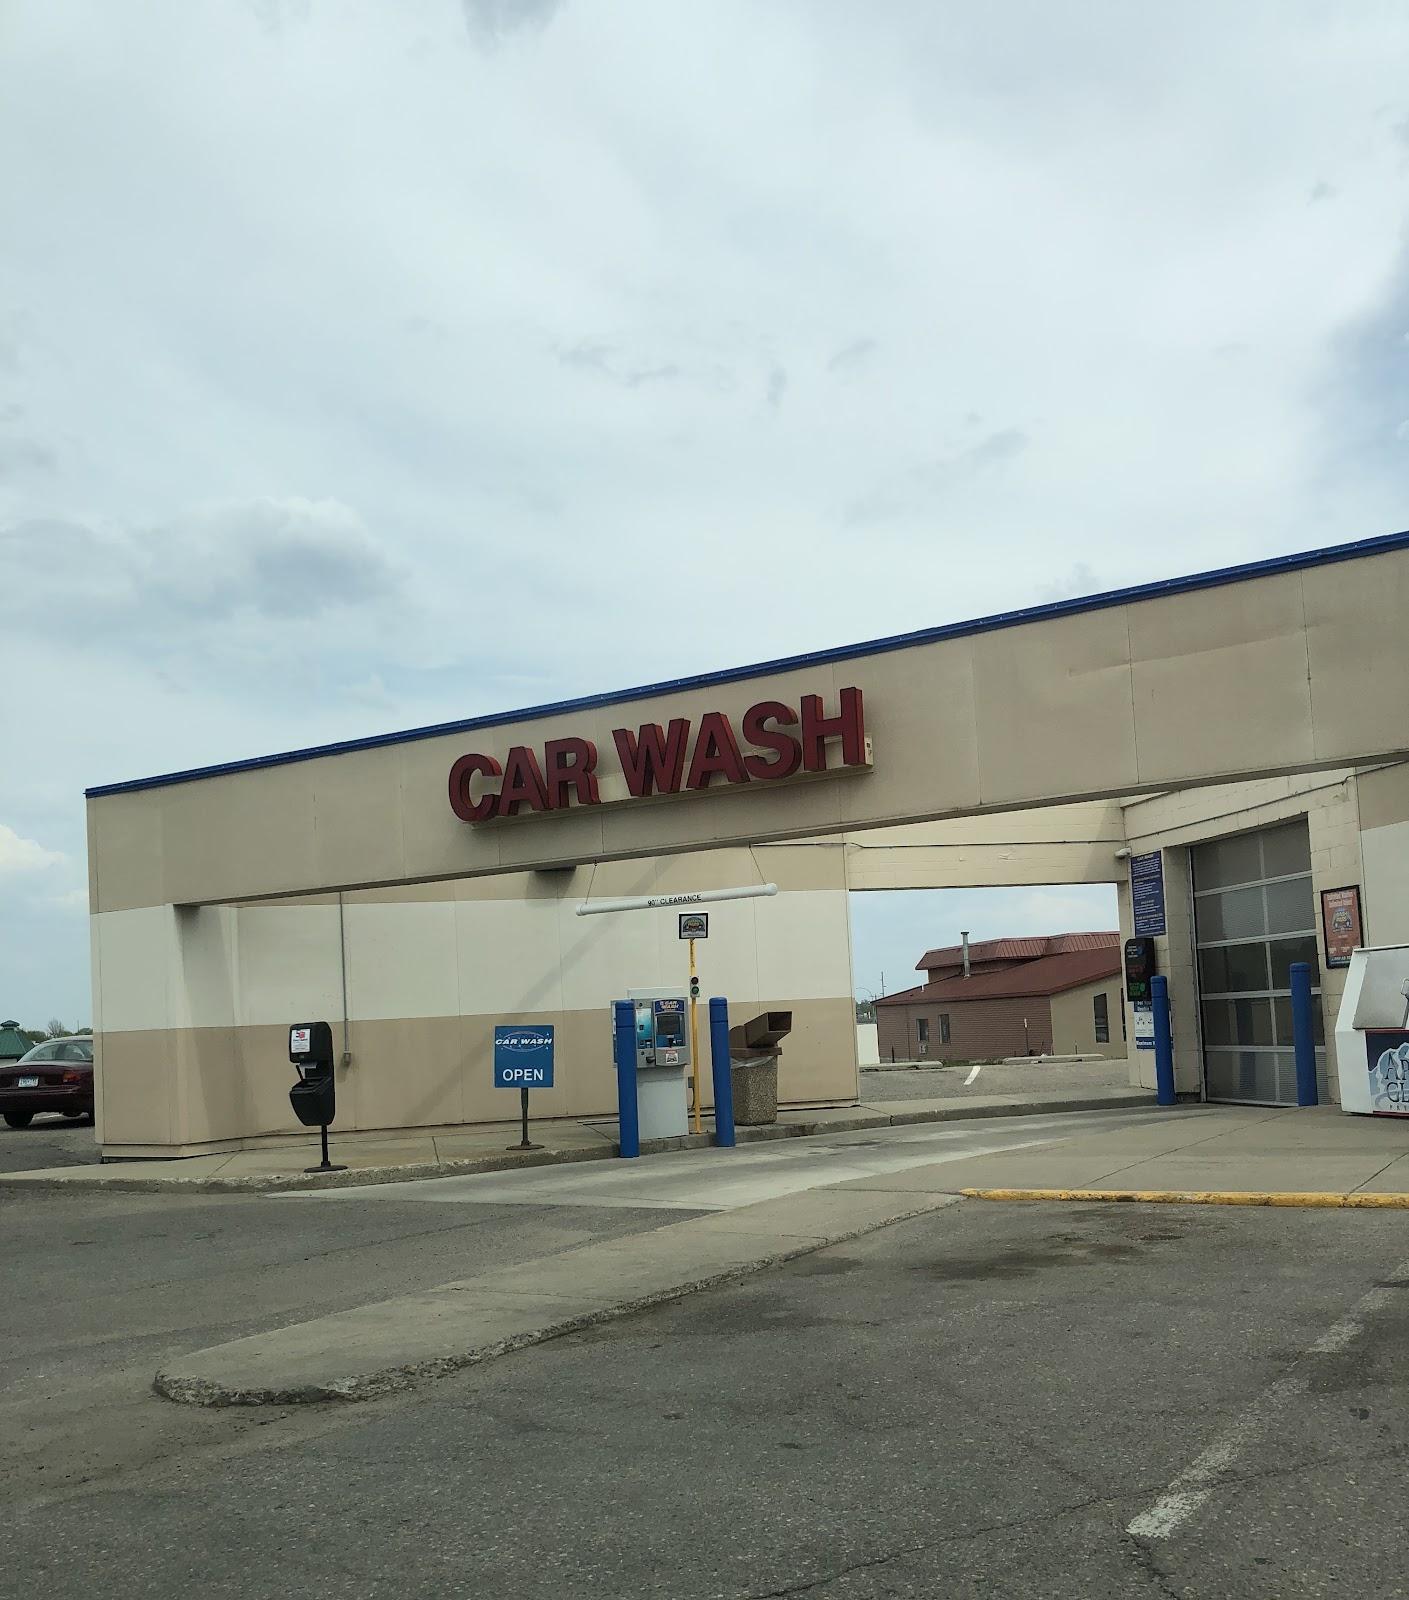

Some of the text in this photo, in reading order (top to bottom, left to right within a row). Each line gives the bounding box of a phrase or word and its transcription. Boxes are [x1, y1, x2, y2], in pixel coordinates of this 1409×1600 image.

[448, 687, 865, 821] CAR WASH
[660, 894, 702, 905] CLEARANCE
[502, 1069, 543, 1081] OPEN
